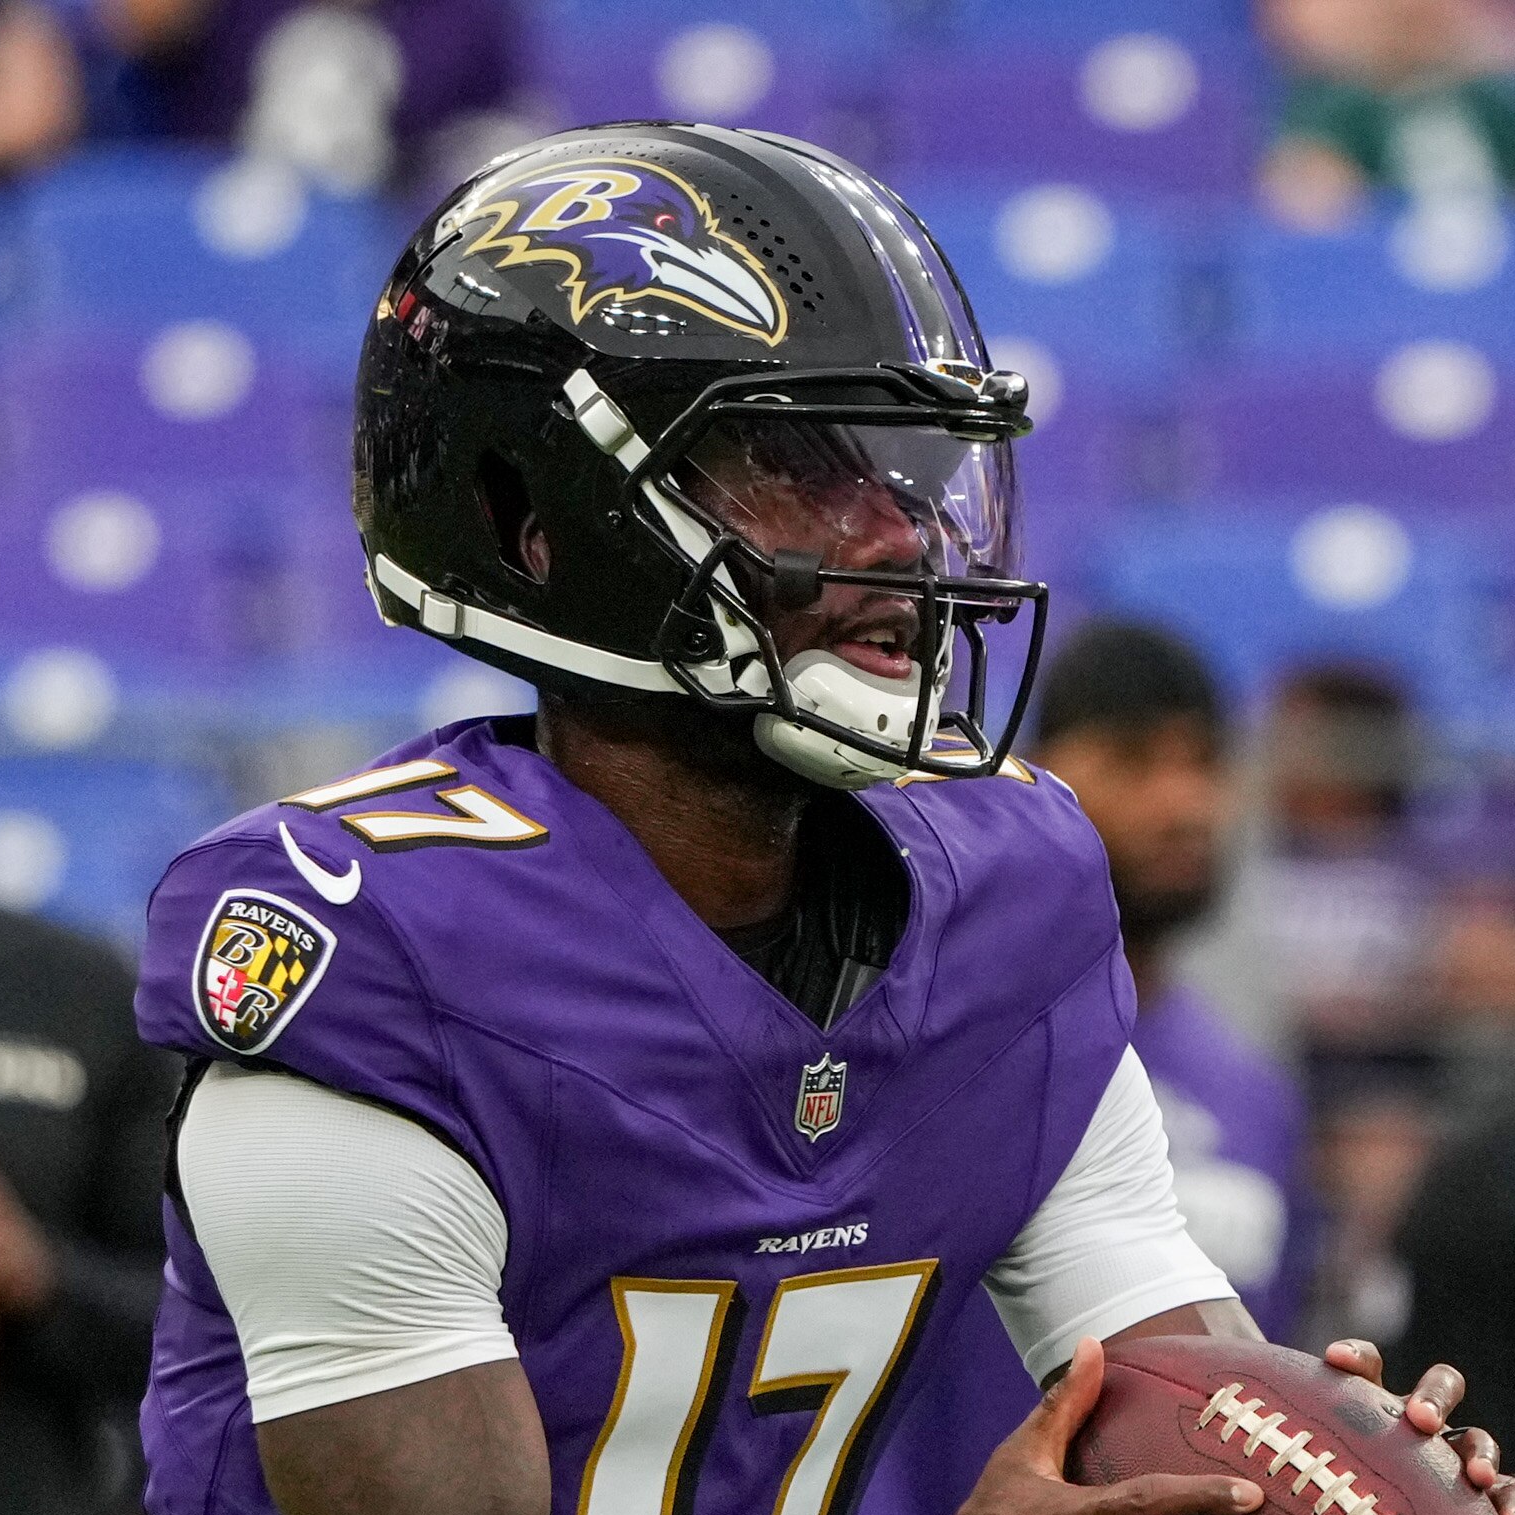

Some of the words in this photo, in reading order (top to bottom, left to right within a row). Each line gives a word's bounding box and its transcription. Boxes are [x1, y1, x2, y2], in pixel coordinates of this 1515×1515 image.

[518, 169, 642, 232] B
[278, 758, 550, 853] 17
[214, 922, 267, 967] B
[228, 902, 317, 952] RAVENS
[802, 1094, 836, 1127] NFL
[754, 1222, 869, 1254] RAVENS
